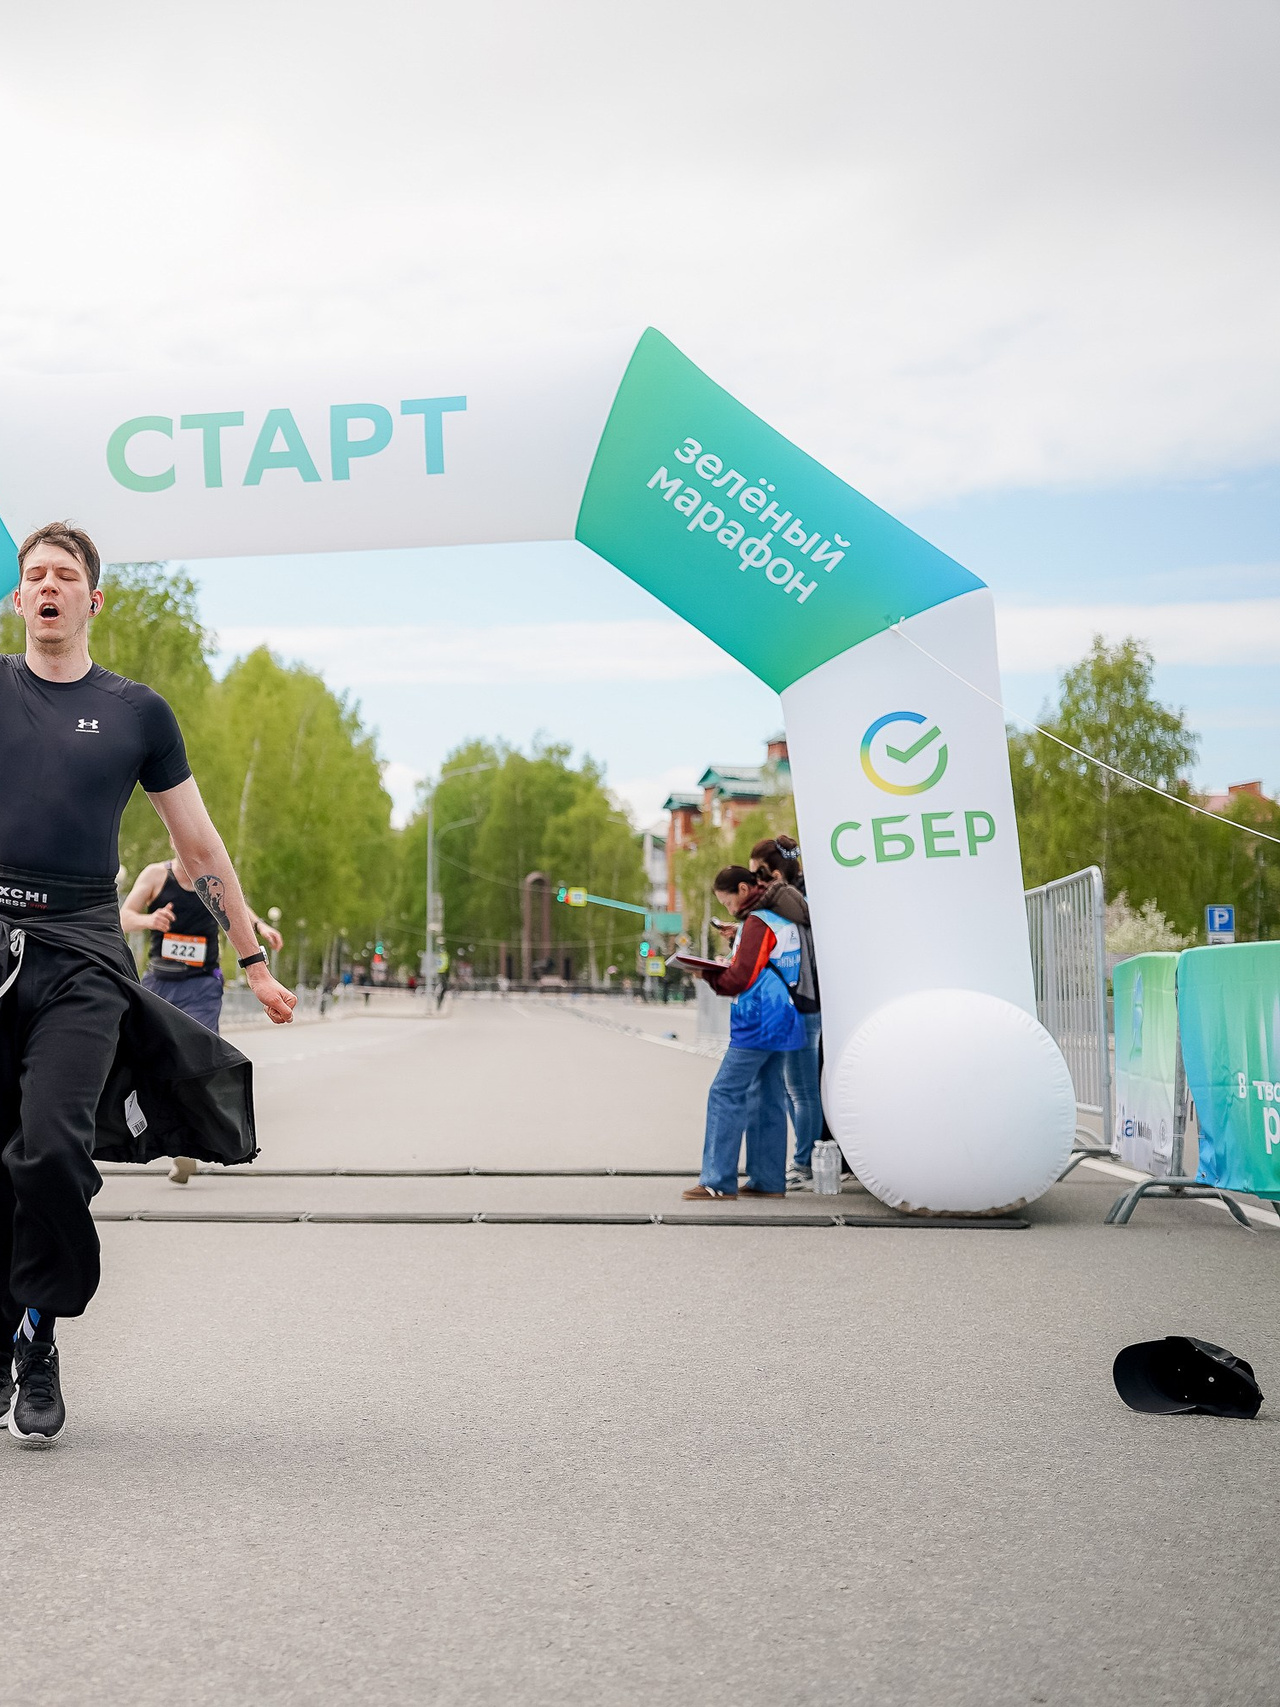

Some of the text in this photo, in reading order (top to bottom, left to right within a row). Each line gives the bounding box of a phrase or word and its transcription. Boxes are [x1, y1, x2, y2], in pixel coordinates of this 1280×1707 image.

[106, 395, 467, 492] СТАРТ
[646, 465, 818, 604] марафон
[674, 437, 851, 573] зелёный
[831, 811, 996, 867] СБЕР
[170, 943, 196, 958] 222
